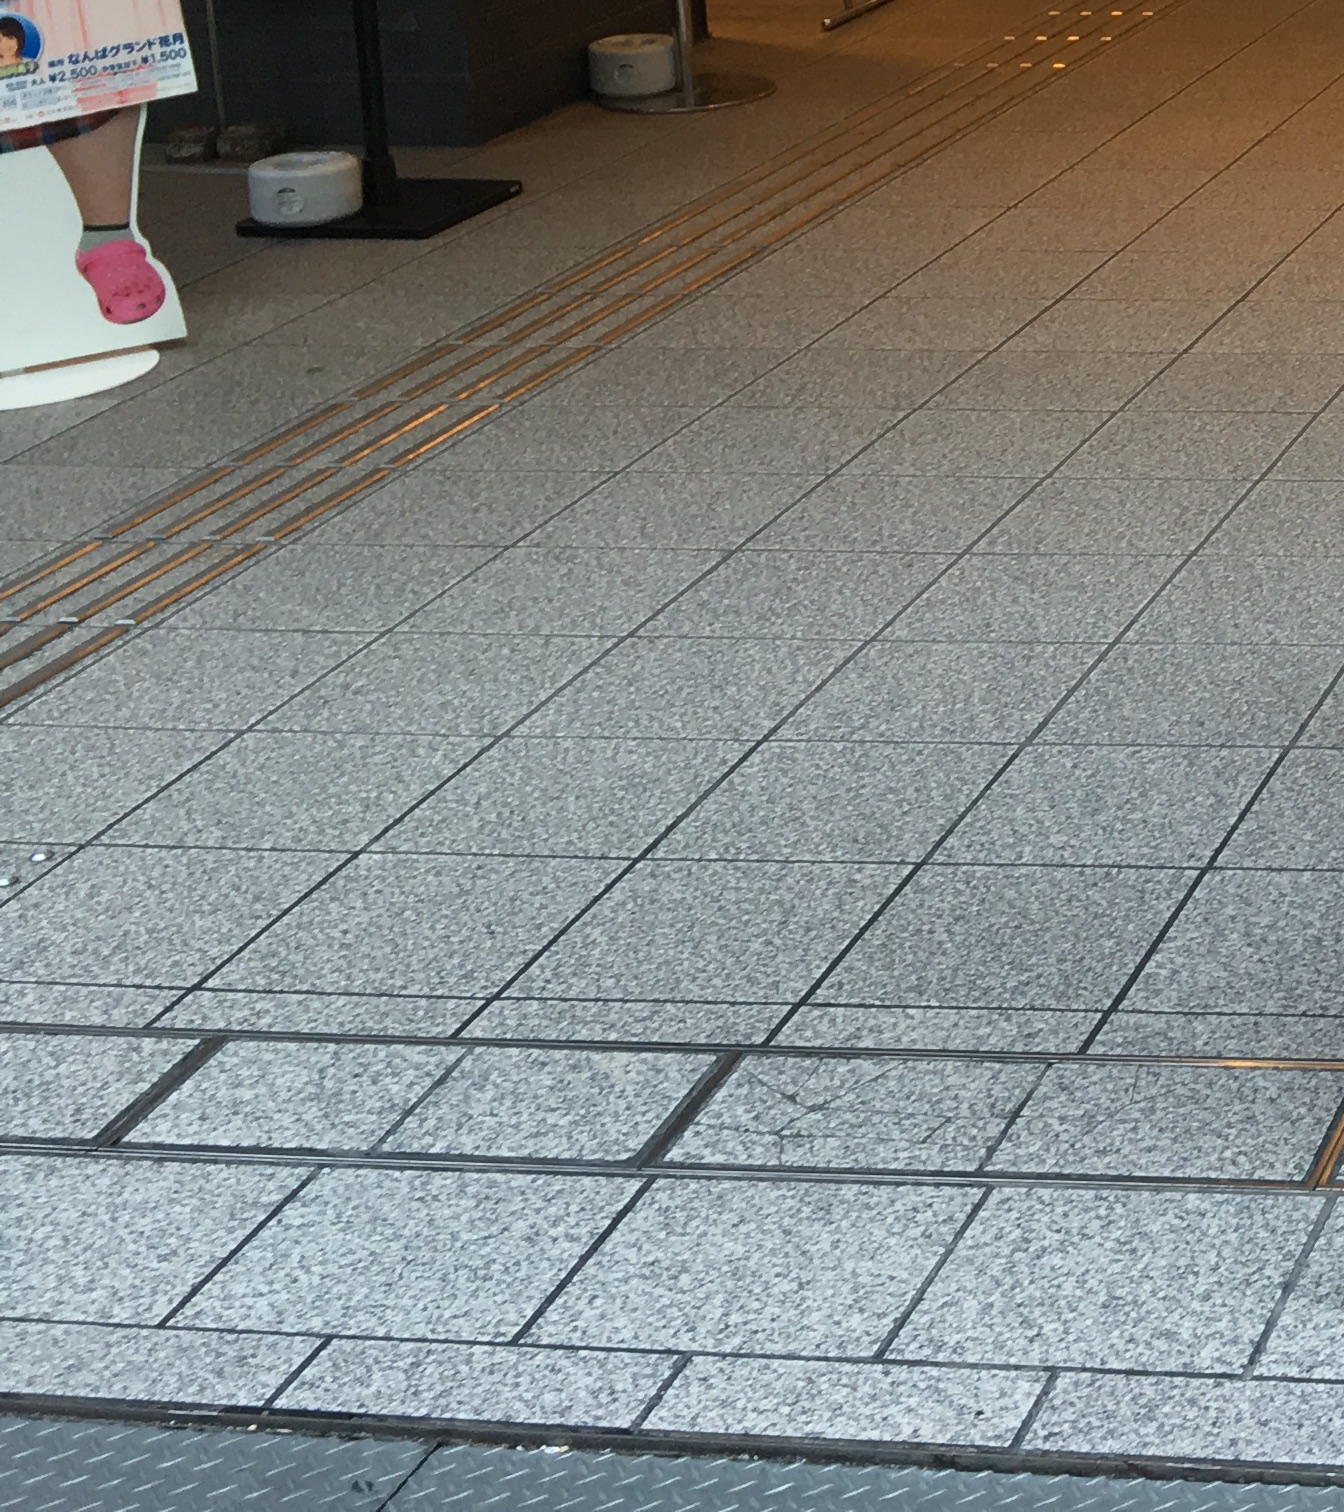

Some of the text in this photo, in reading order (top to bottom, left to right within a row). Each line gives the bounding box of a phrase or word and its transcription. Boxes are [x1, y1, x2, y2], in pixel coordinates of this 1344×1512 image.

[66, 32, 185, 66] なんばグランド花月
